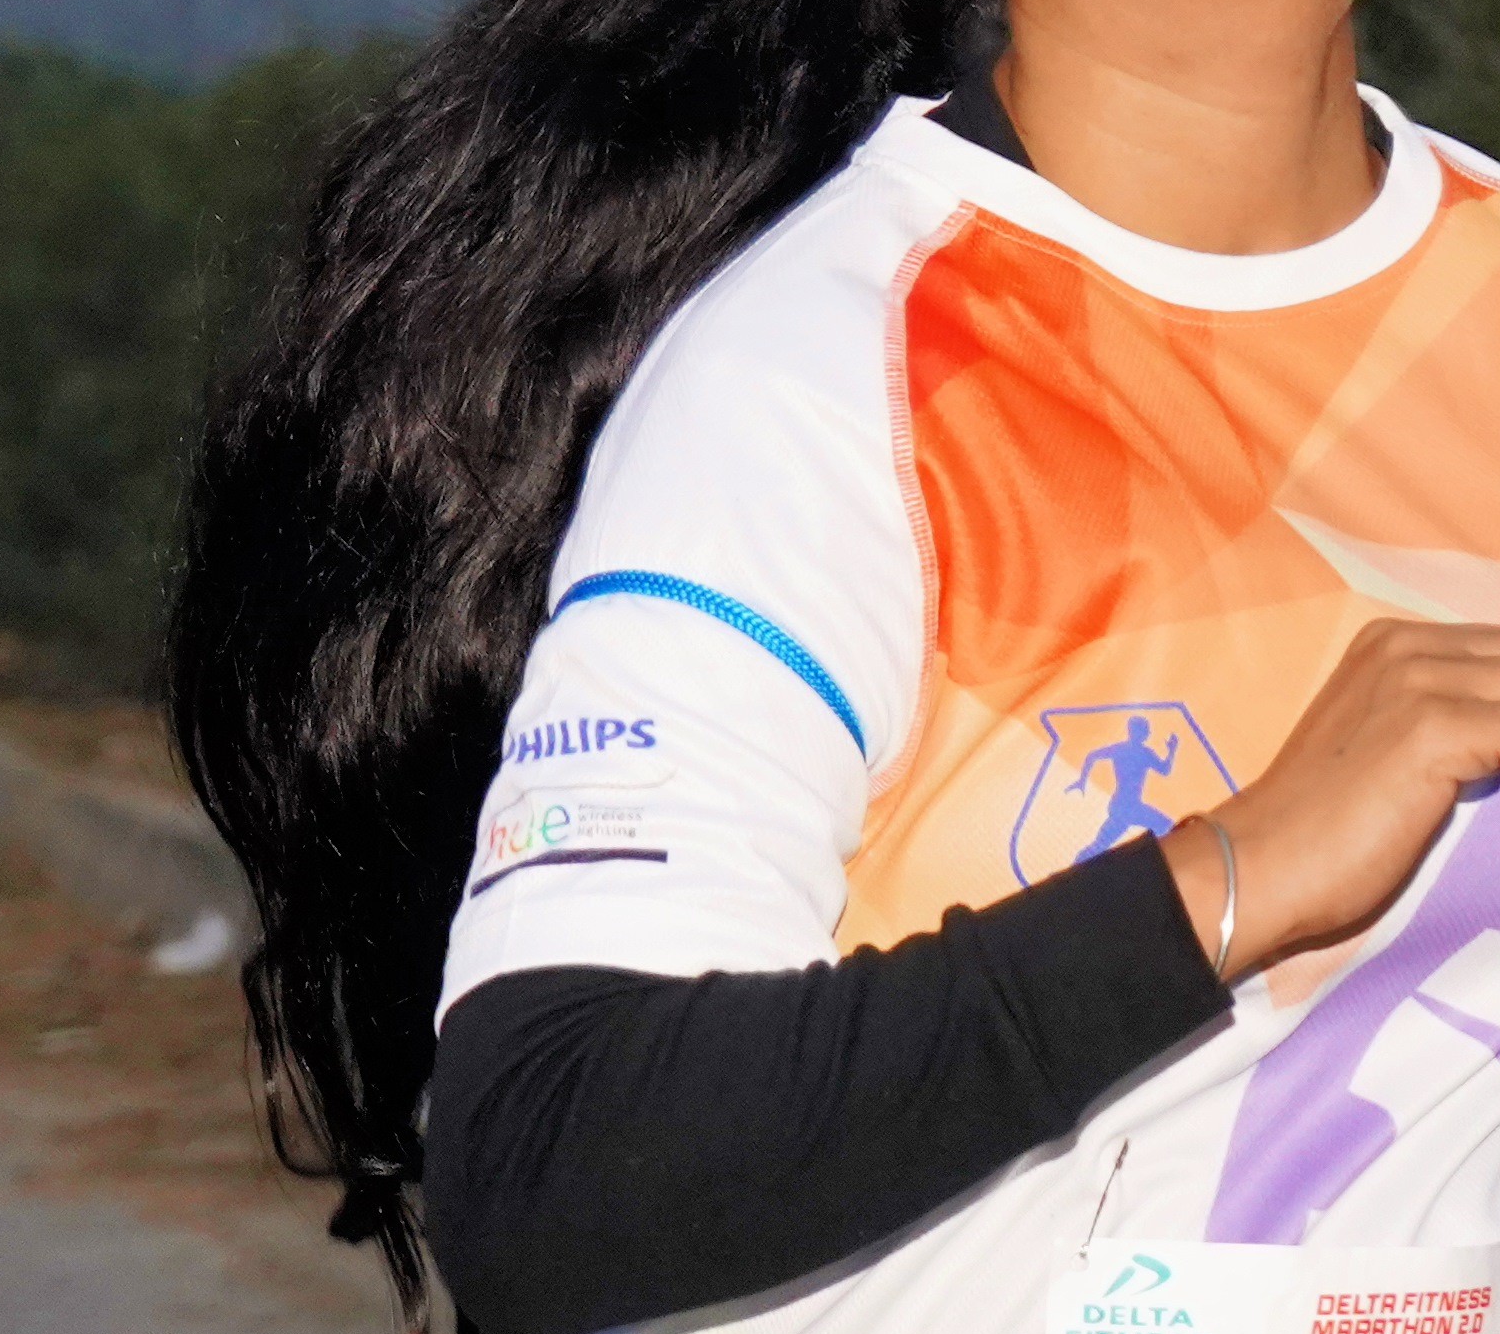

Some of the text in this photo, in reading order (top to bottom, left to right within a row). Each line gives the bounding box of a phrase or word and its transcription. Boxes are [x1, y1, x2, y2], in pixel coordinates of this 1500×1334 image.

[1317, 1286, 1492, 1316] DELTA FITNESS
[1083, 1304, 1193, 1328] DELTA
